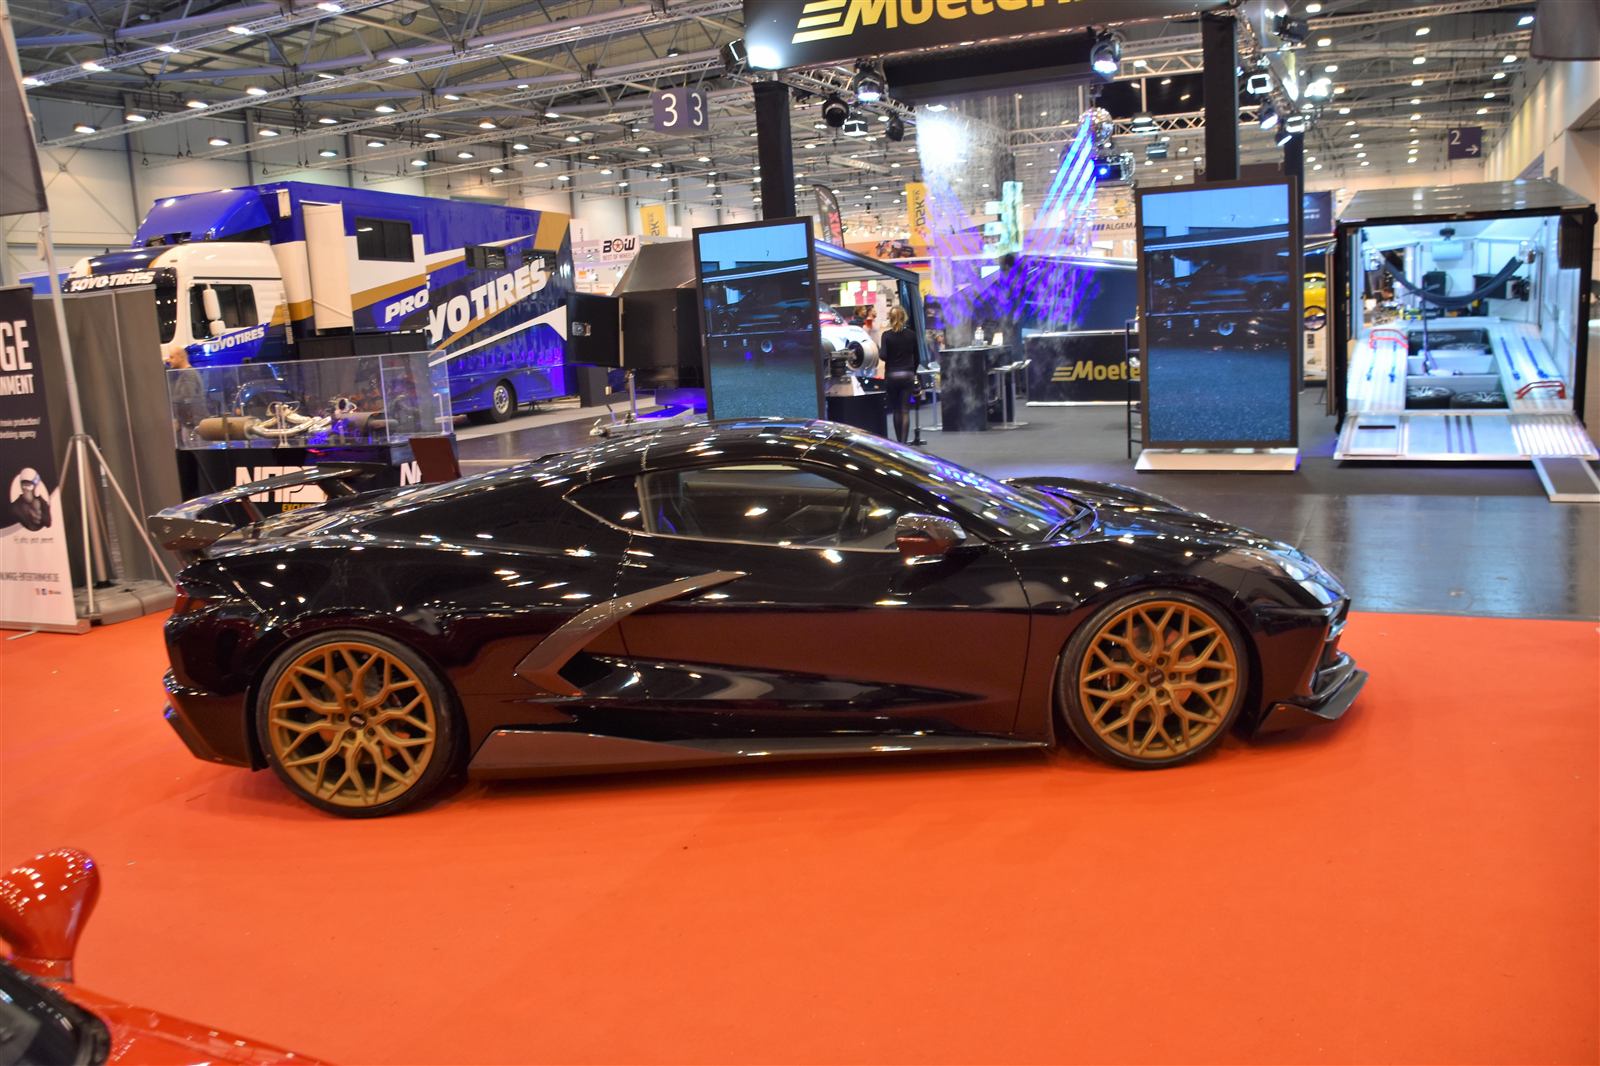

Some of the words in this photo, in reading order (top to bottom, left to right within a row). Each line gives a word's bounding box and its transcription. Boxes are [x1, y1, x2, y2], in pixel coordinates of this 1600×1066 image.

[661, 93, 678, 127] 3
[691, 92, 703, 126] 3
[1450, 130, 1461, 145] 2
[70, 275, 109, 292] TOYO
[109, 271, 156, 286] TIRES
[470, 258, 546, 321] TIRES
[234, 327, 265, 346] TIRES
